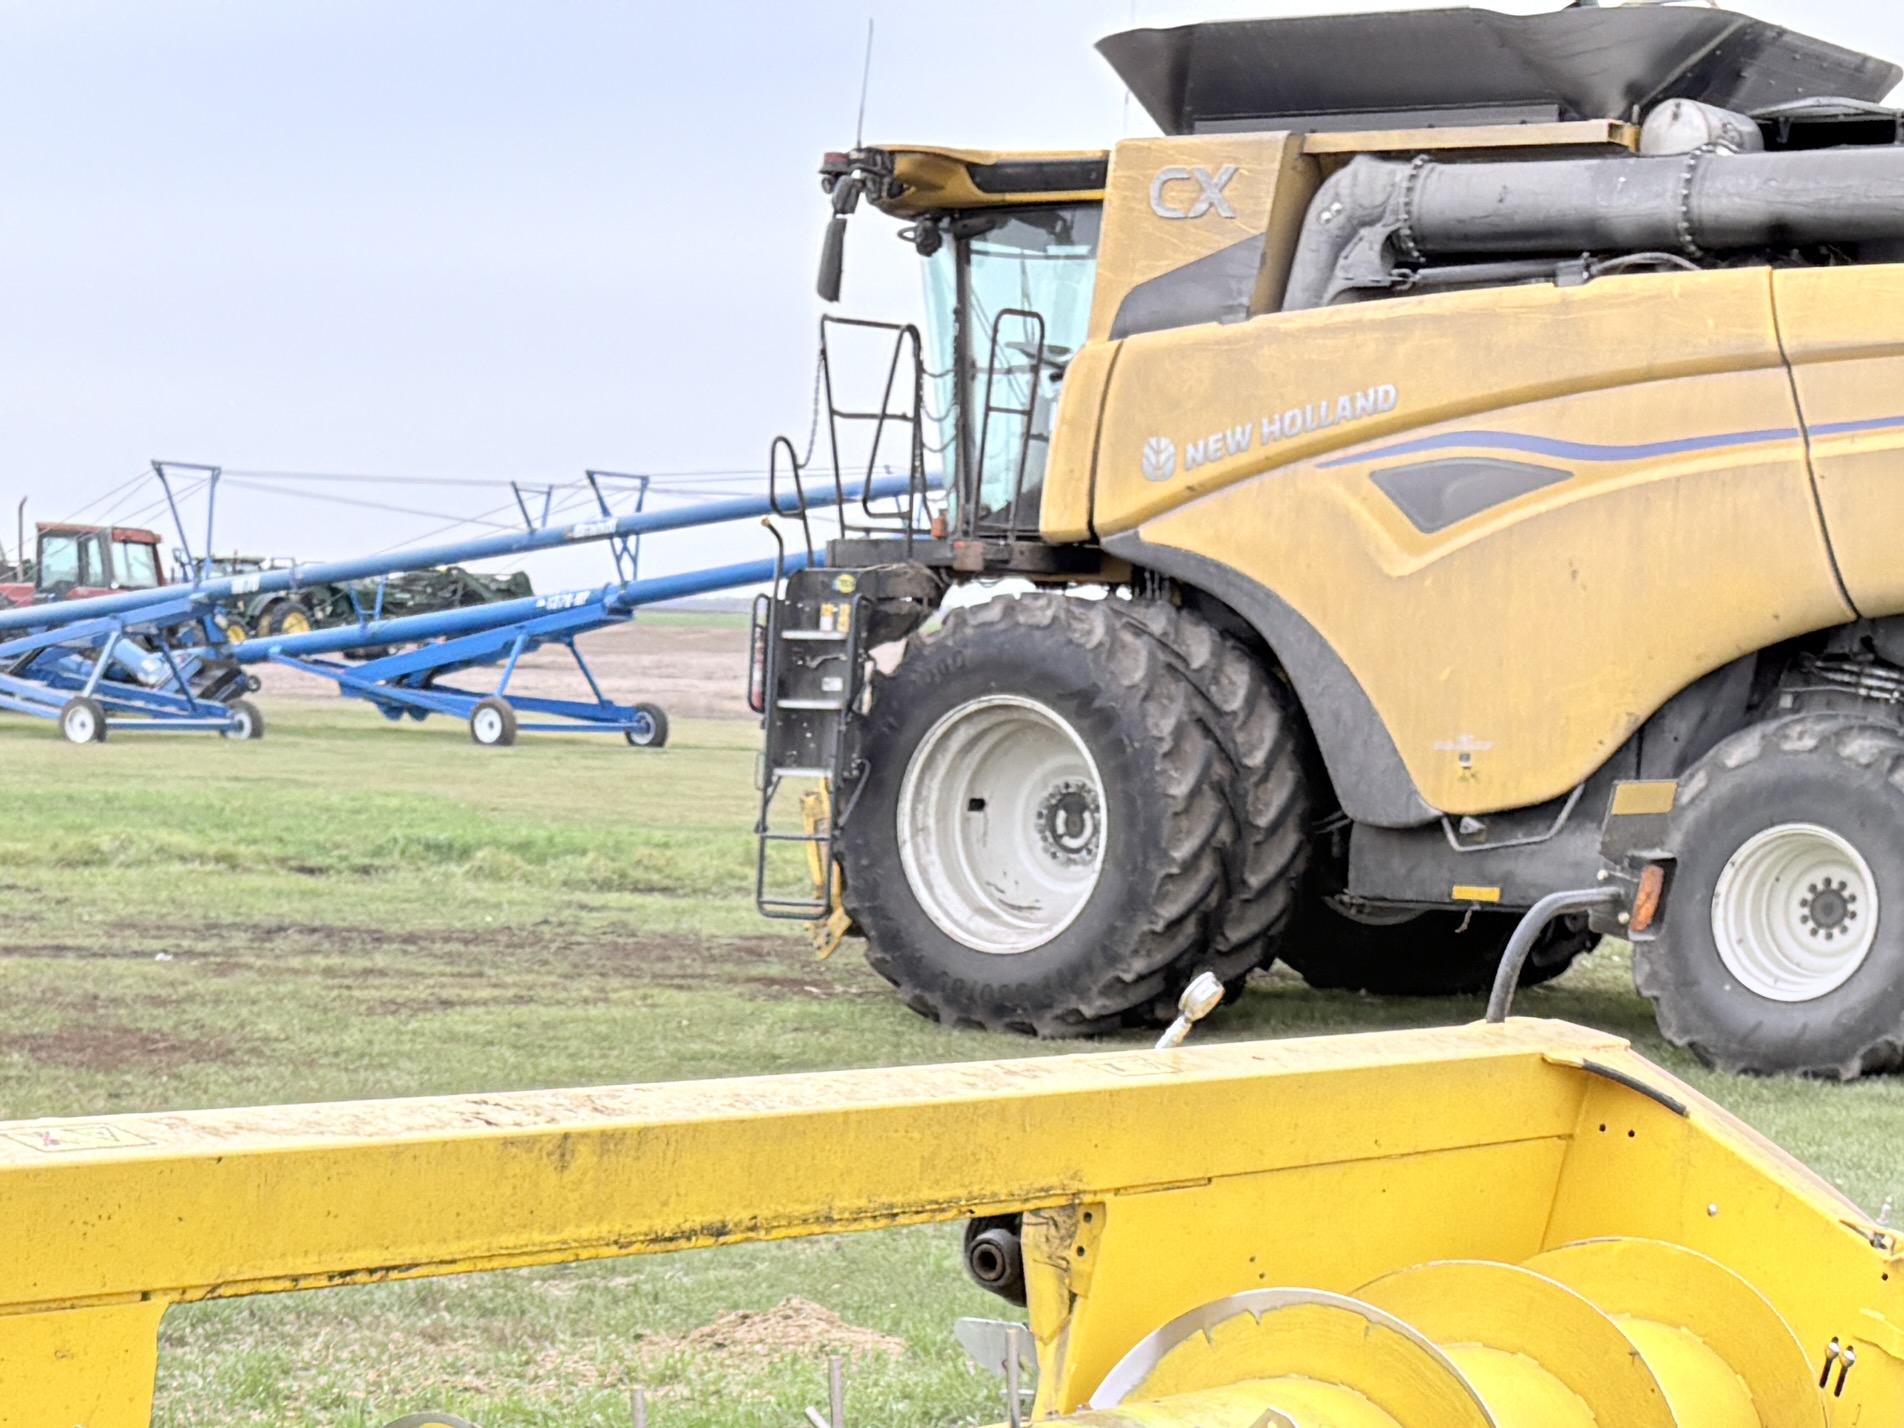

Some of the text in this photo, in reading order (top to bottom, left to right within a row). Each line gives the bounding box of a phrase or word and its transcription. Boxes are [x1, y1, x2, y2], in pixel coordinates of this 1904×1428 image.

[1150, 165, 1240, 219] CX
[1183, 383, 1398, 470] NEW HOLLAND
